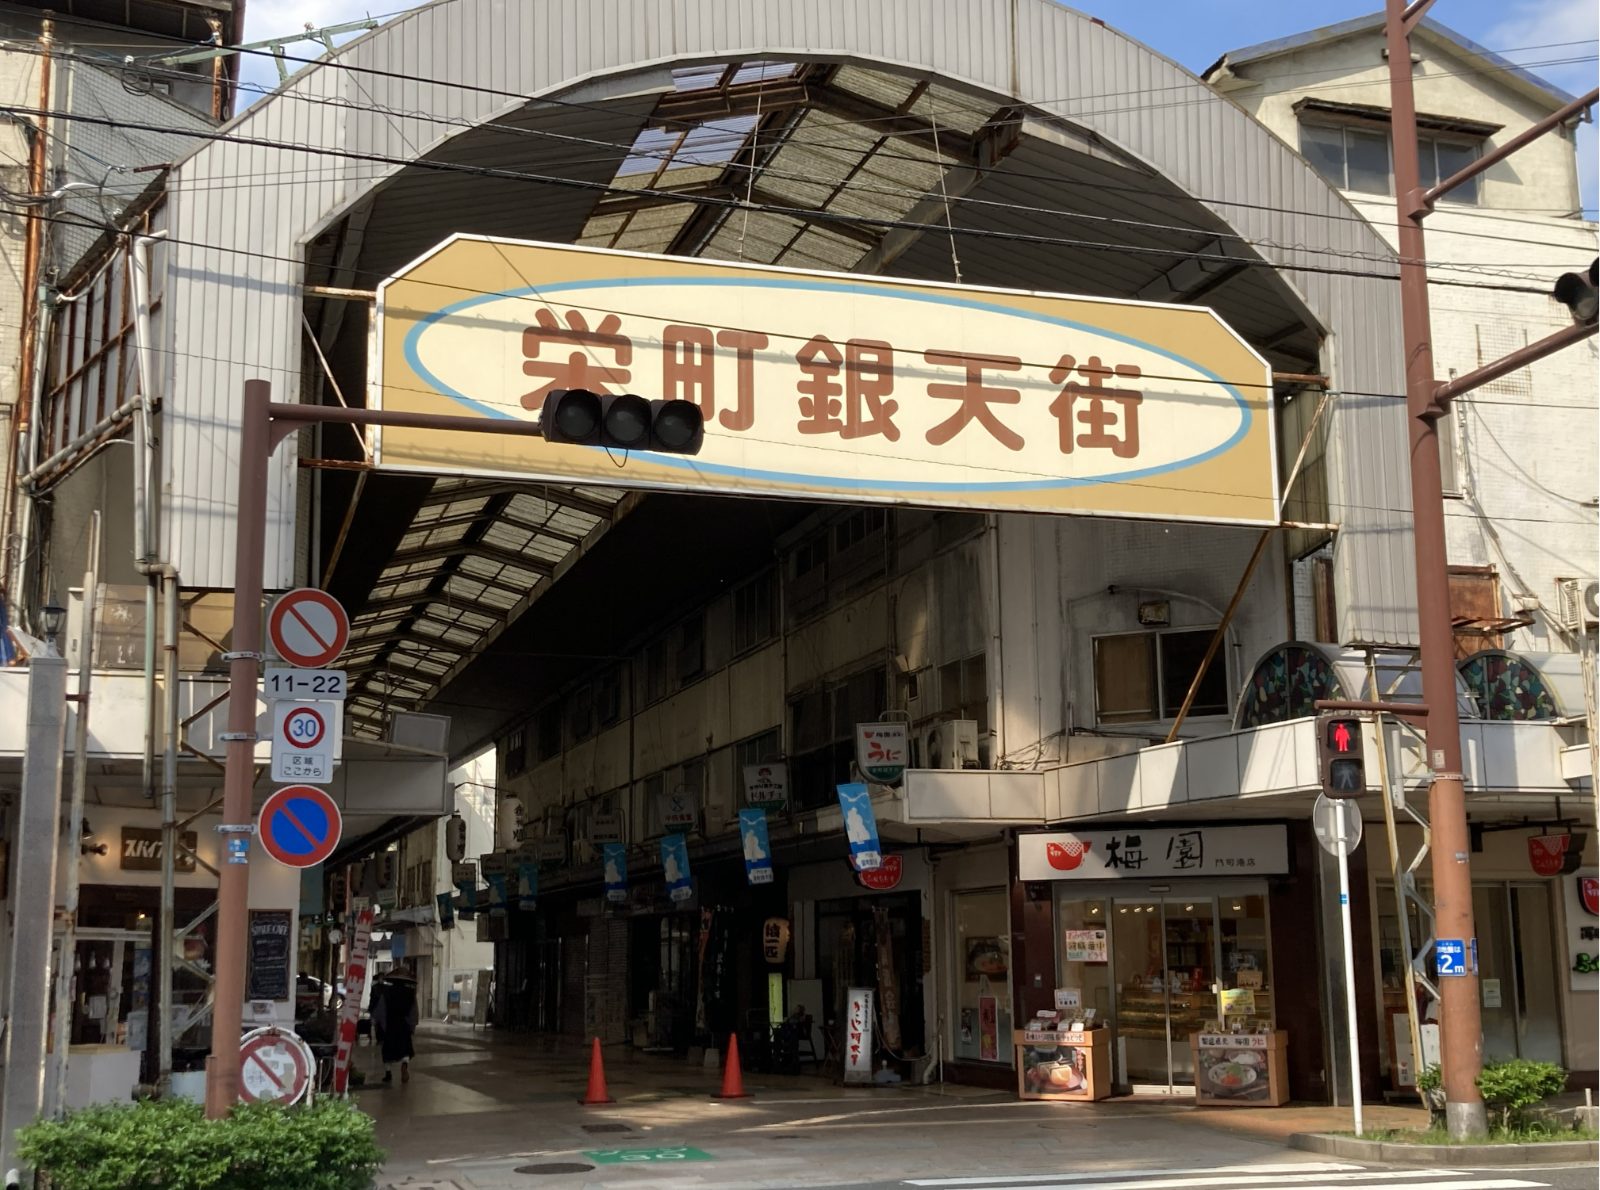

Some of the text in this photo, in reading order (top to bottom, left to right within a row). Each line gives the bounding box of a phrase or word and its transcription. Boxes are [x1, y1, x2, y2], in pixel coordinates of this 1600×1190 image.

[521, 308, 1143, 458] 栄町銀天街
[271, 675, 341, 693] 11-22
[293, 719, 317, 737] 30
[293, 756, 313, 765] 区域
[283, 766, 322, 776] ここから
[1105, 831, 1202, 869] 梅園
